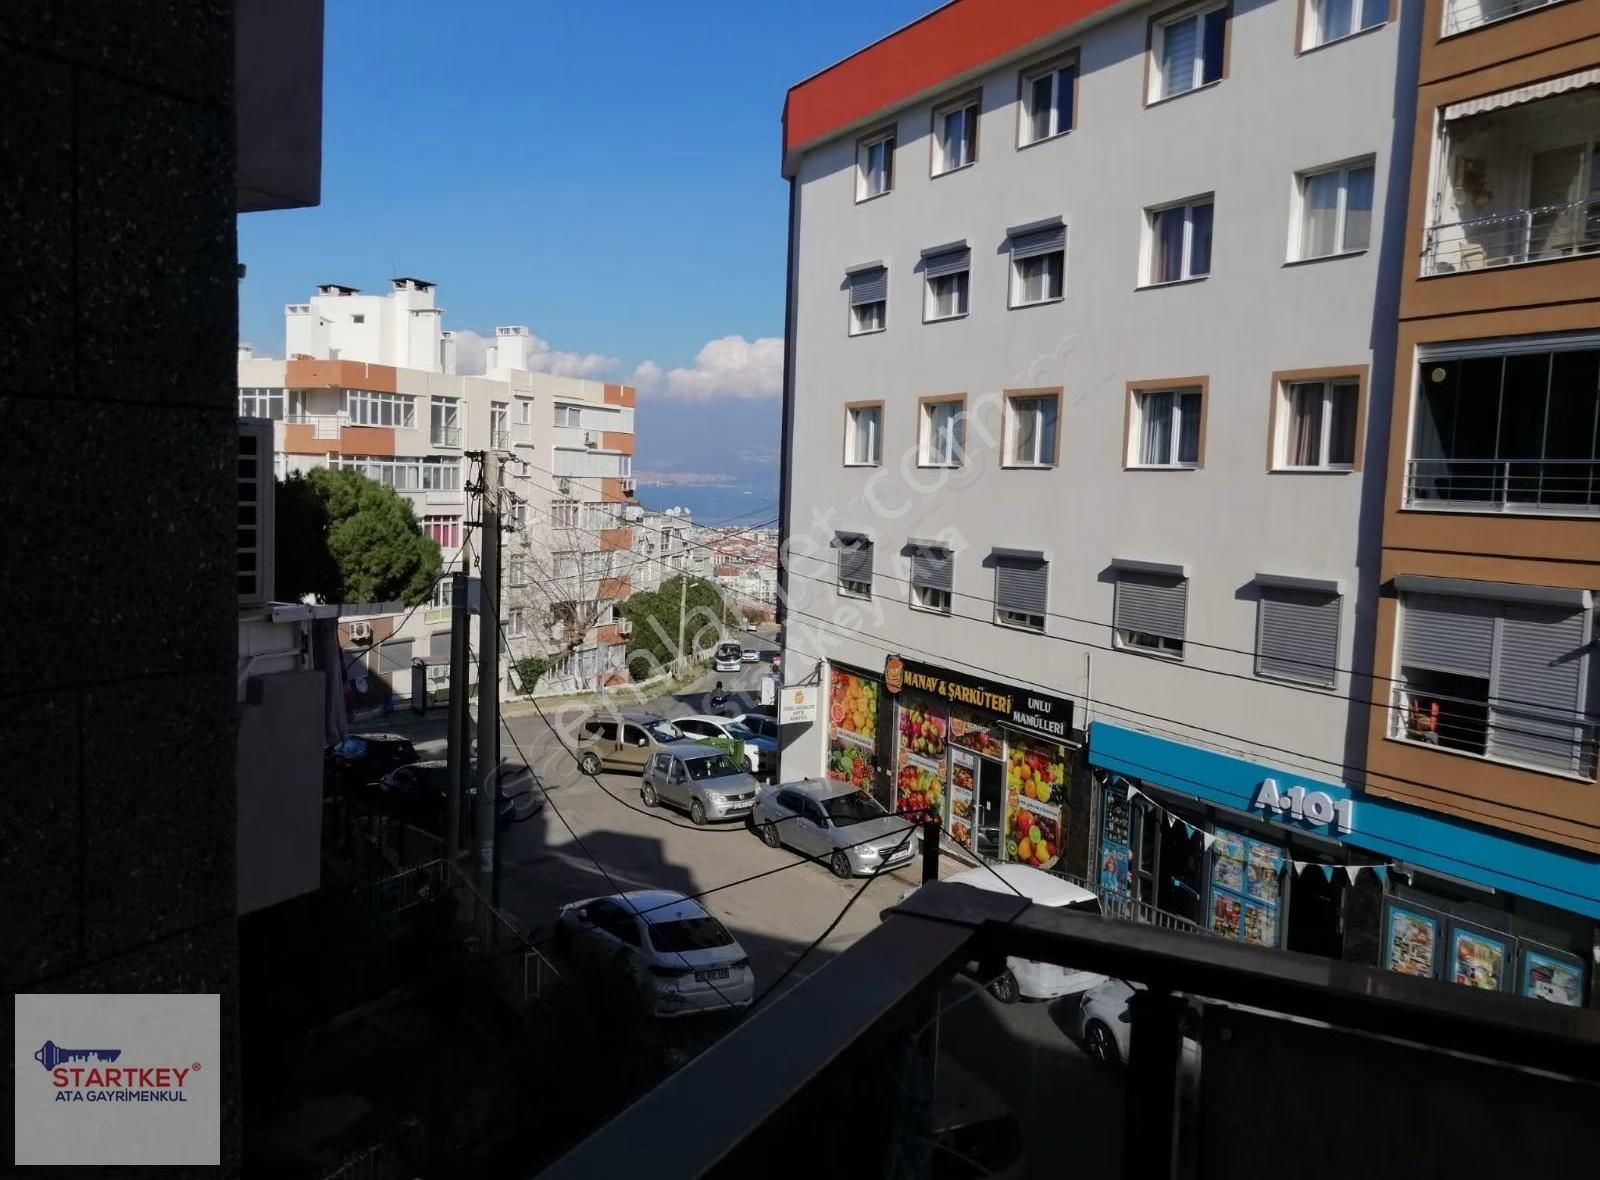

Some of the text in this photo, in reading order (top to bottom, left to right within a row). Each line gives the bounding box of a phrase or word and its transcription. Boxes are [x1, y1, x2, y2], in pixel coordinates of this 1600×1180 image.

[904, 671, 1012, 714] MANAV & ŞARKÜTERİ
[1027, 698, 1051, 713] UNLU
[1013, 711, 1064, 735] MAMÜLLERİ
